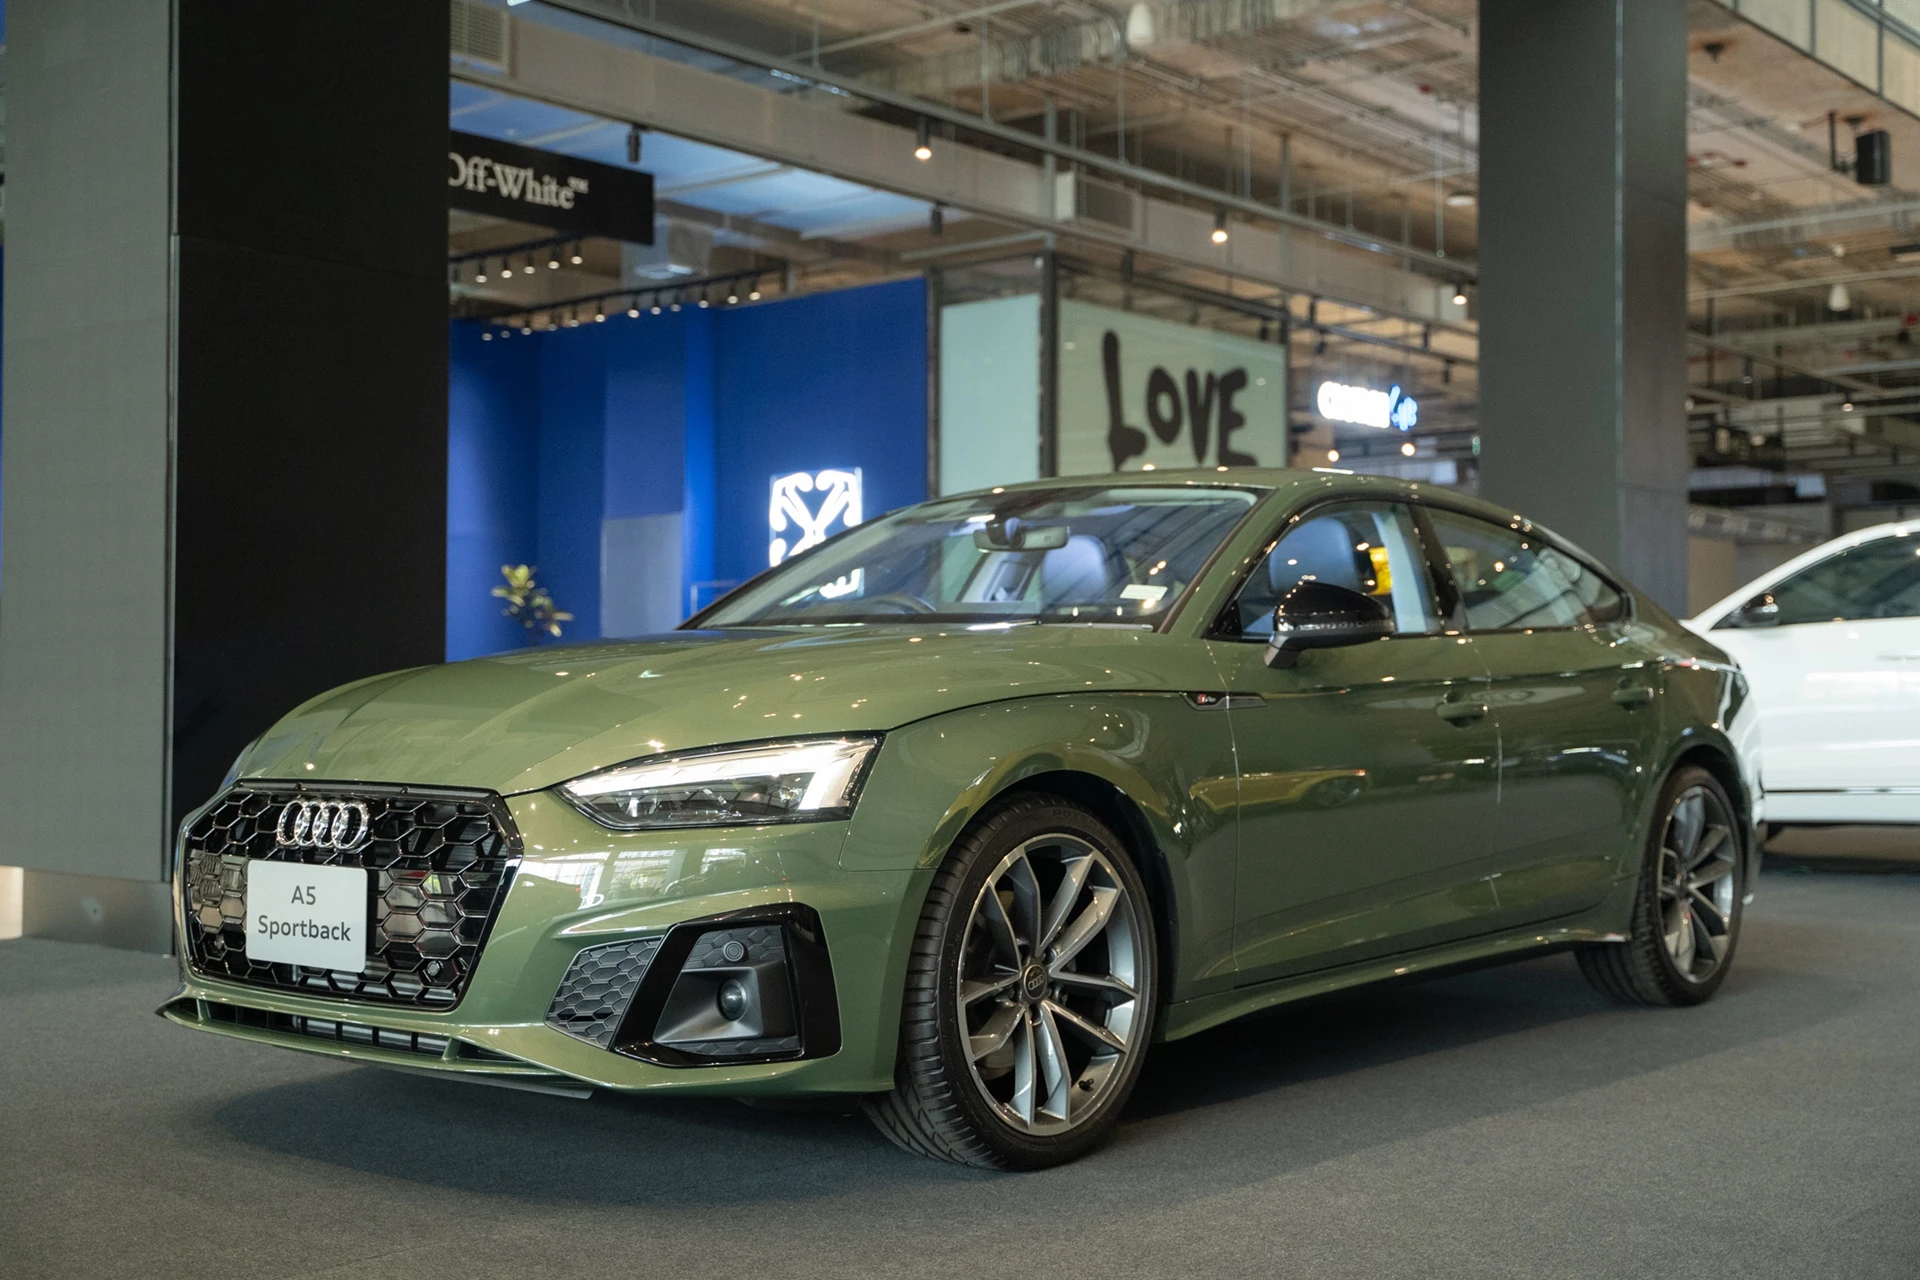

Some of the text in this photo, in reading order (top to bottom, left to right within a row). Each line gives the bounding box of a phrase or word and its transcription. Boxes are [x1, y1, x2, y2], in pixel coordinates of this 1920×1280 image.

[1103, 329, 1258, 472] LOVE
[291, 885, 317, 906] A5
[258, 914, 352, 942] Sportback
